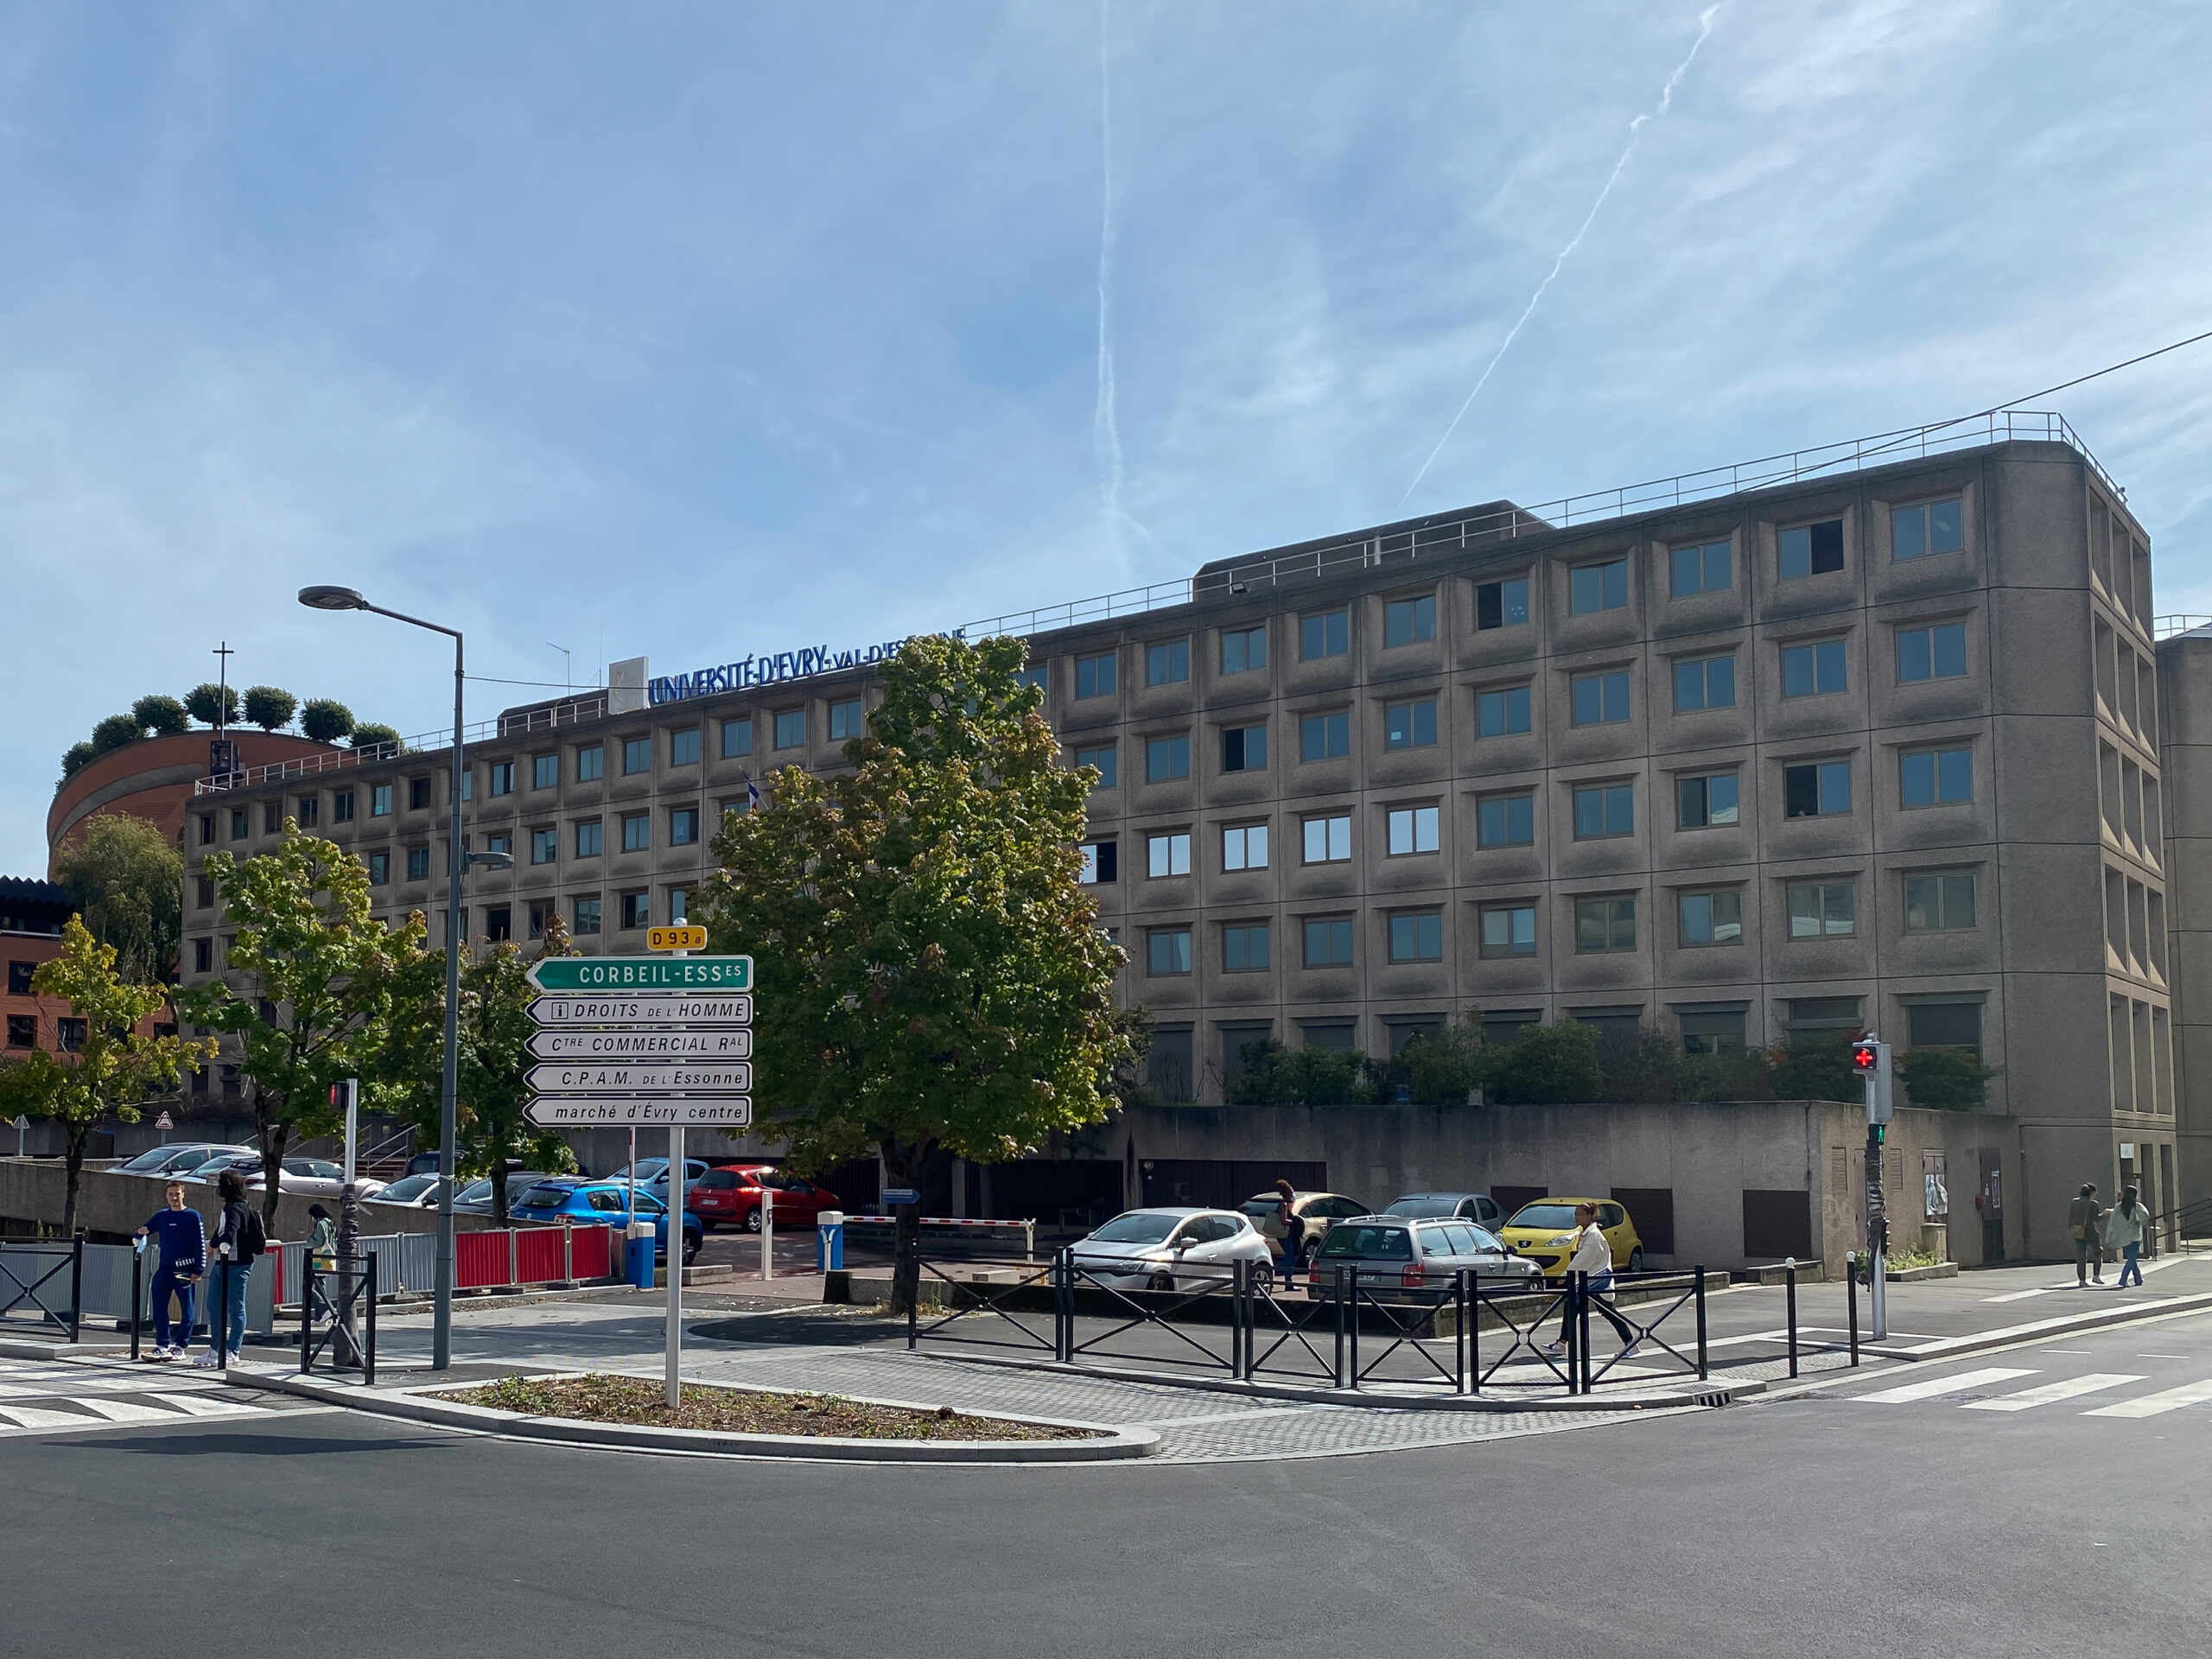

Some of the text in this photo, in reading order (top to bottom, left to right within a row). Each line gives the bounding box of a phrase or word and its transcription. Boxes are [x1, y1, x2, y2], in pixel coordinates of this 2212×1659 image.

[652, 932, 663, 944] D
[575, 1003, 639, 1017] DROITS
[647, 1007, 663, 1017] DE
[666, 1002, 744, 1017] L'HOMME
[592, 1037, 709, 1052] COMMERCIAL
[718, 1038, 743, 1052] RAL
[562, 1070, 743, 1086] C.P.A.M. DE L'Essonne
[555, 1101, 743, 1122] marché d'Évry centre
